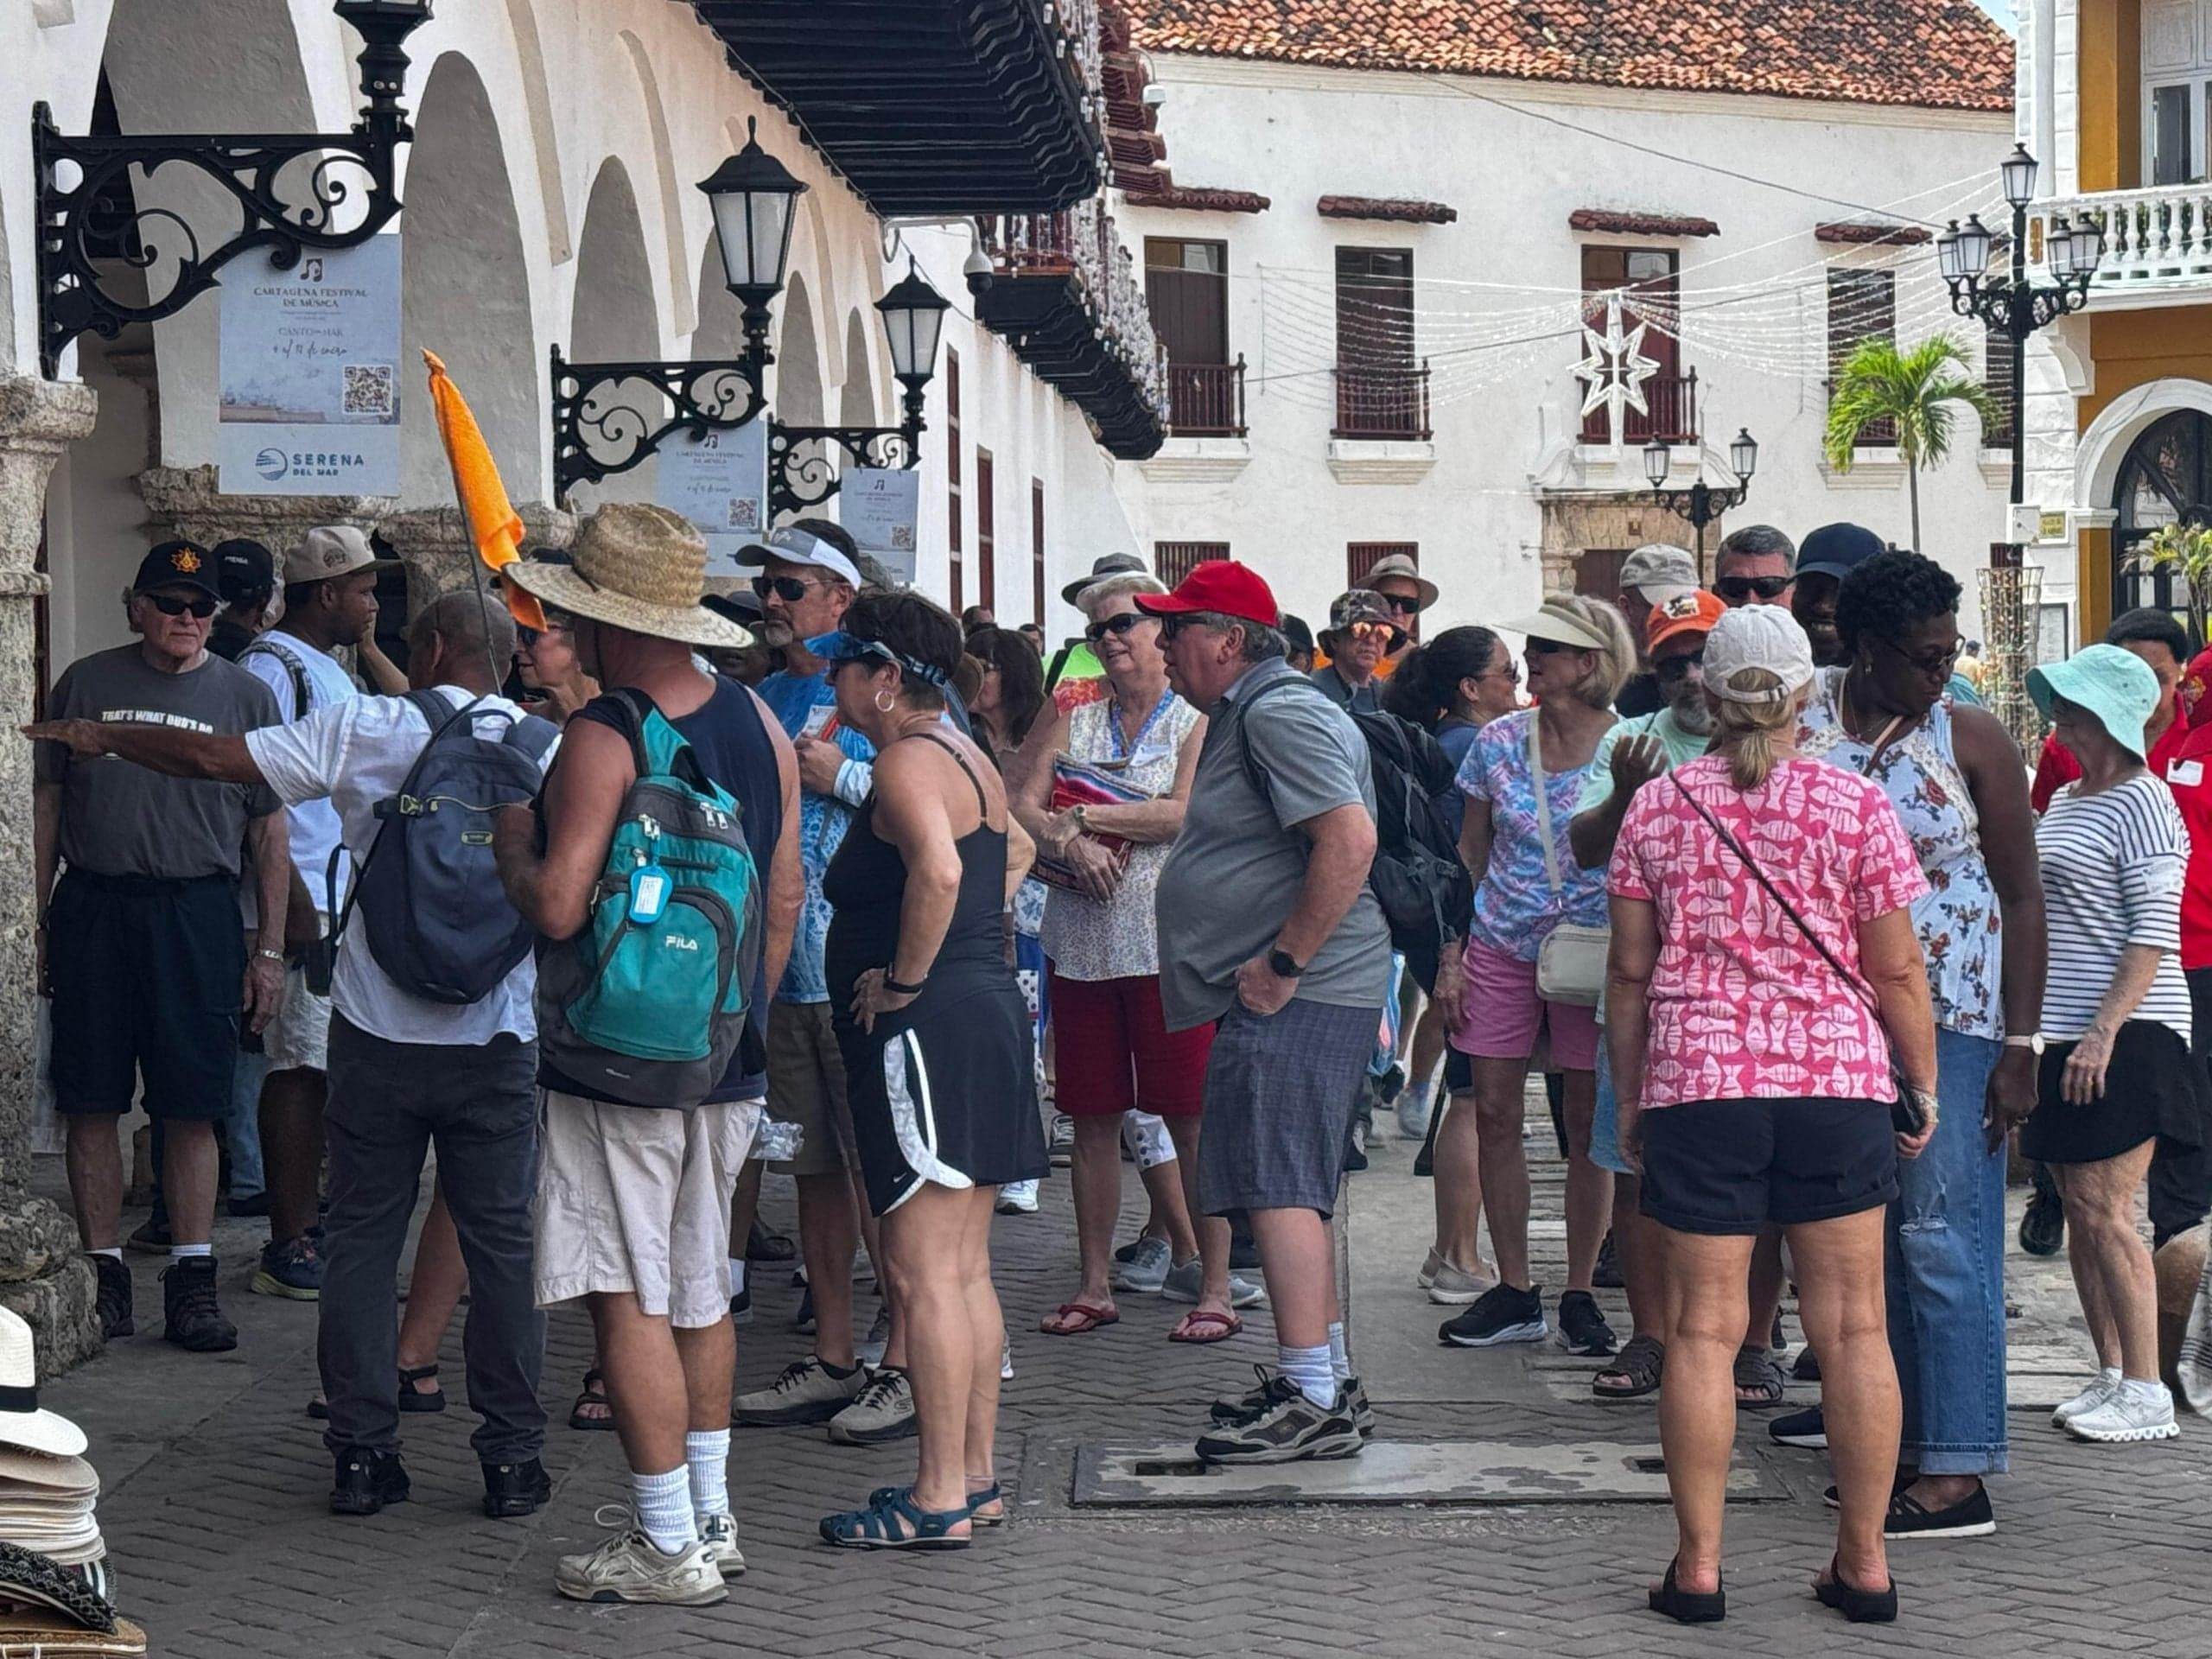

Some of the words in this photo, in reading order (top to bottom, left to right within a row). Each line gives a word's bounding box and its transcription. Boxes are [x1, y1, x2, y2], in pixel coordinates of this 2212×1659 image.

[253, 287, 318, 297] CARTAGENA
[321, 288, 367, 298] FESTIVAL
[292, 453, 365, 466] SERENA
[102, 709, 134, 721] THAT'S
[135, 710, 166, 724] WHAT
[665, 935, 698, 950] FILA
